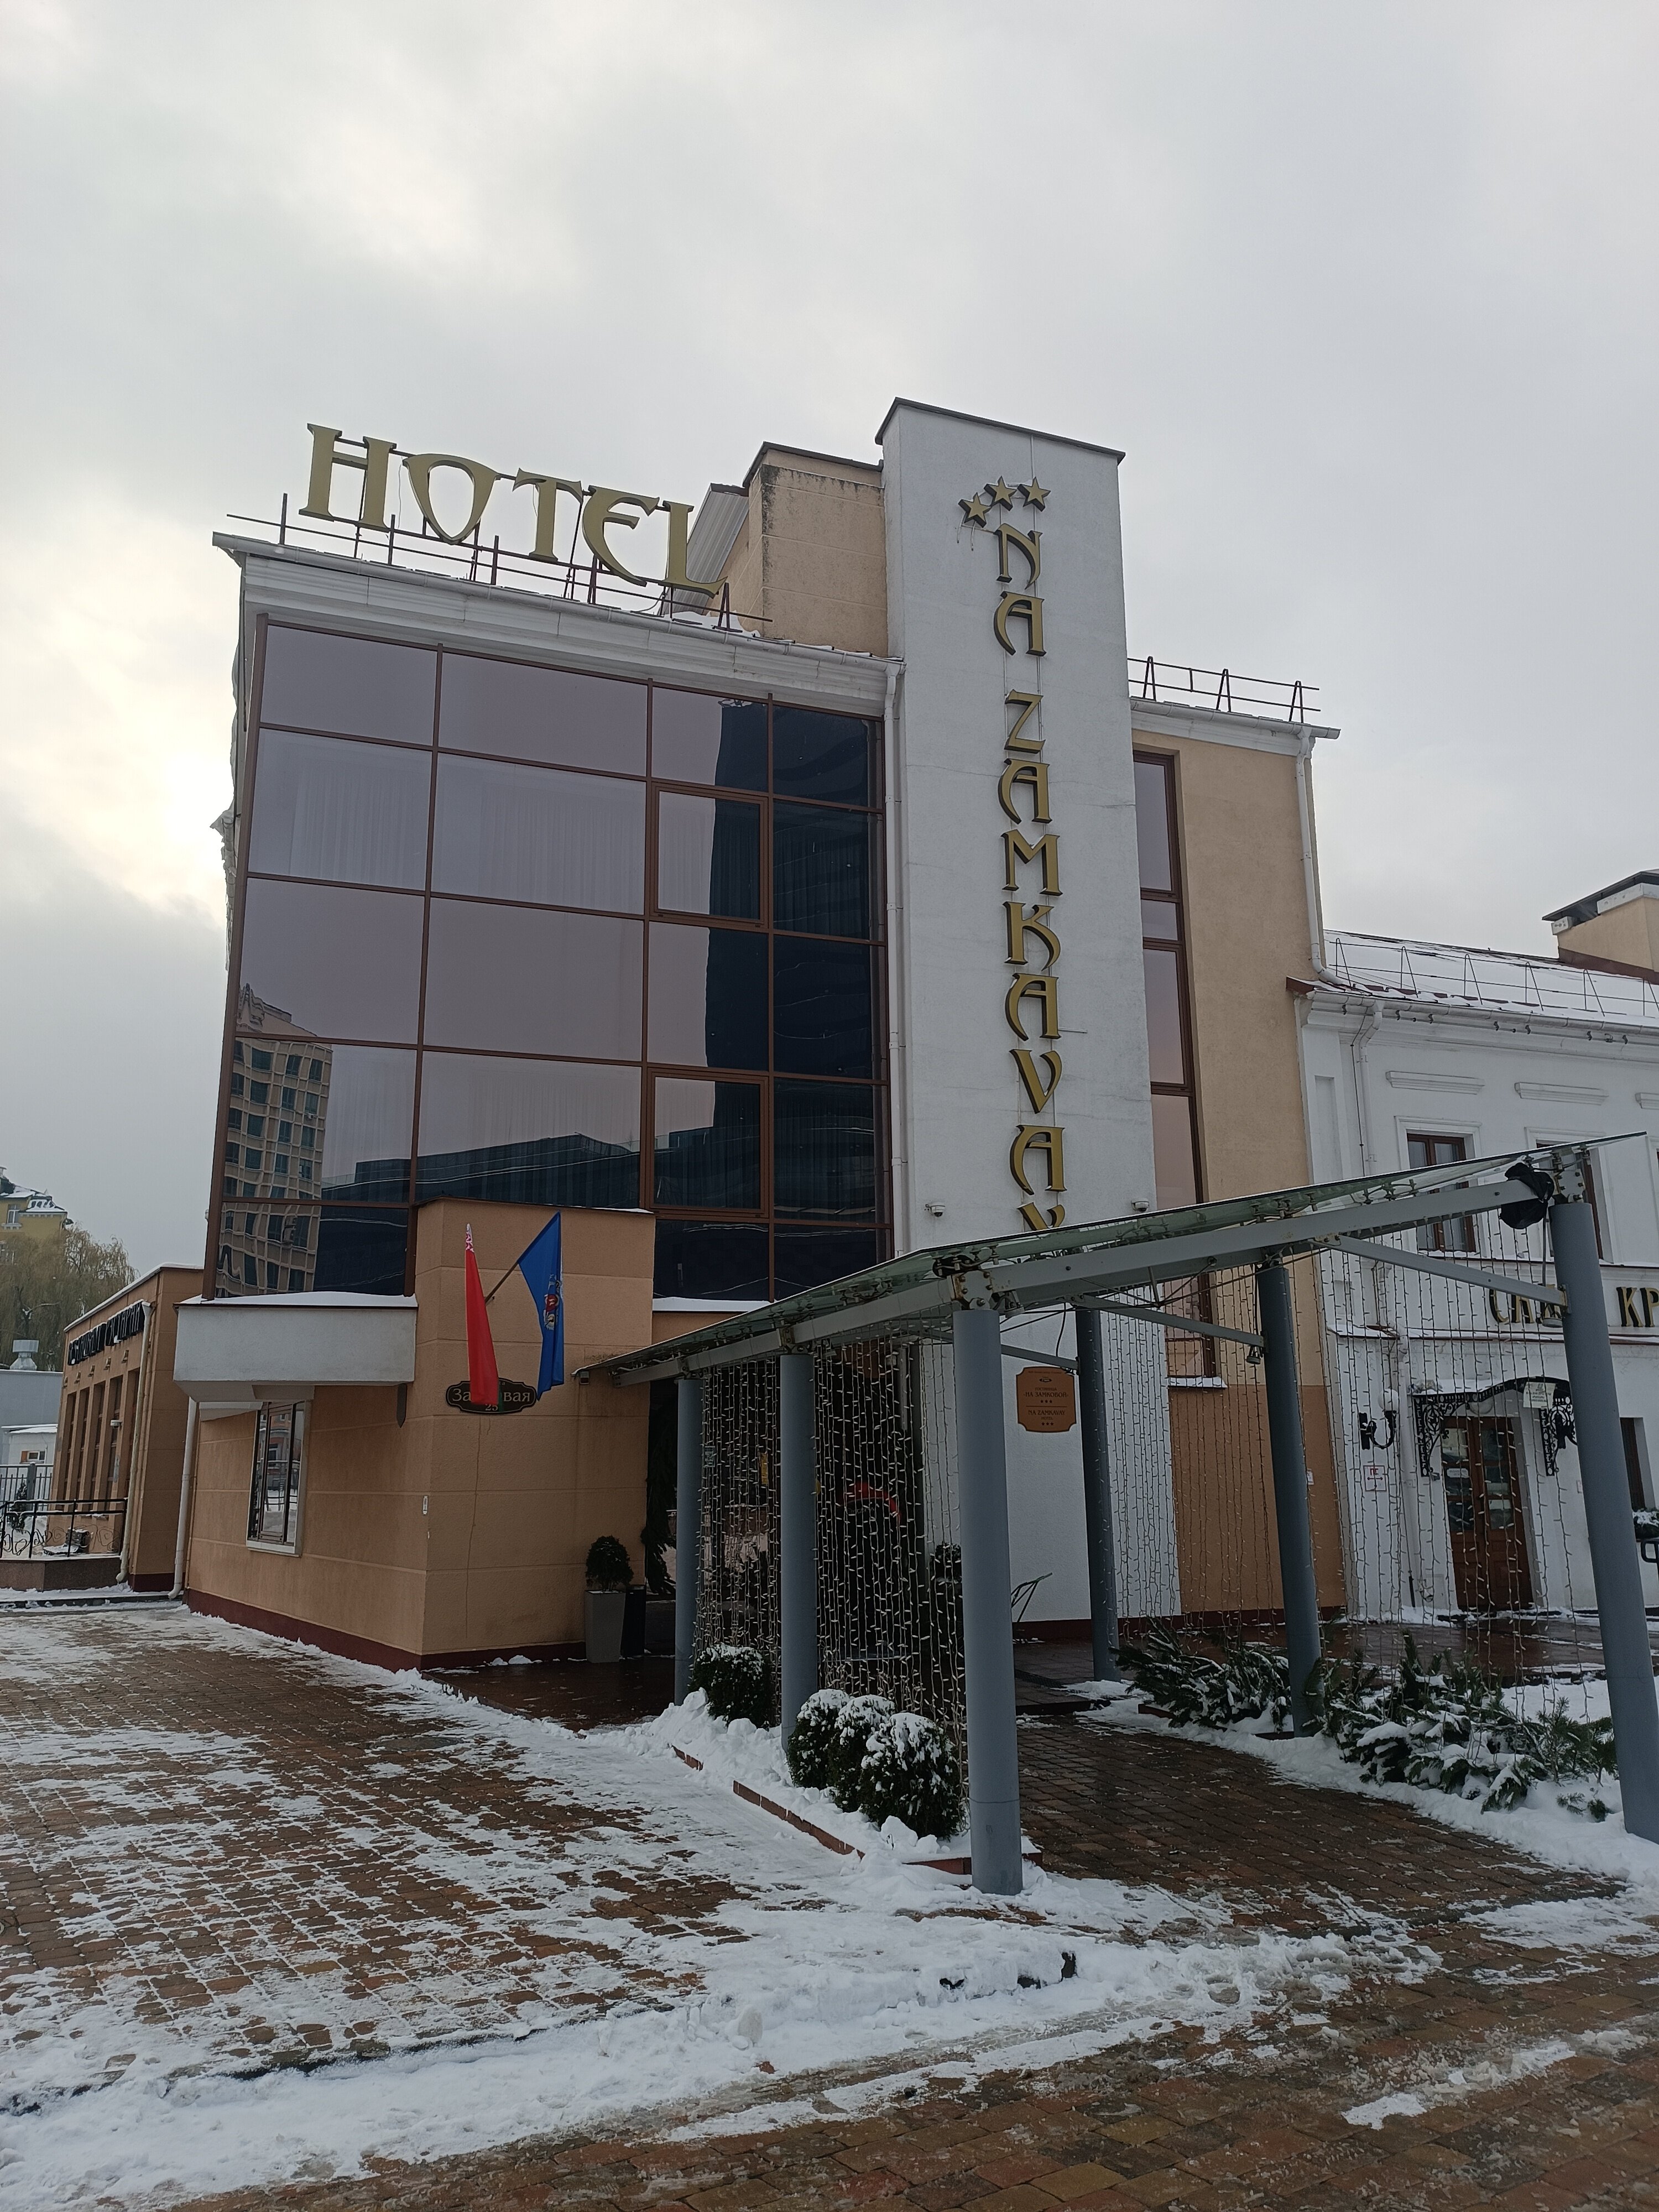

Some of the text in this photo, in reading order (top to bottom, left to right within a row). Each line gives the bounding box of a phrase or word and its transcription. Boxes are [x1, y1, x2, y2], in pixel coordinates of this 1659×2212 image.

[299, 423, 728, 598] HOTEL
[993, 523, 1047, 657] NA
[452, 1388, 530, 1402] Завая
